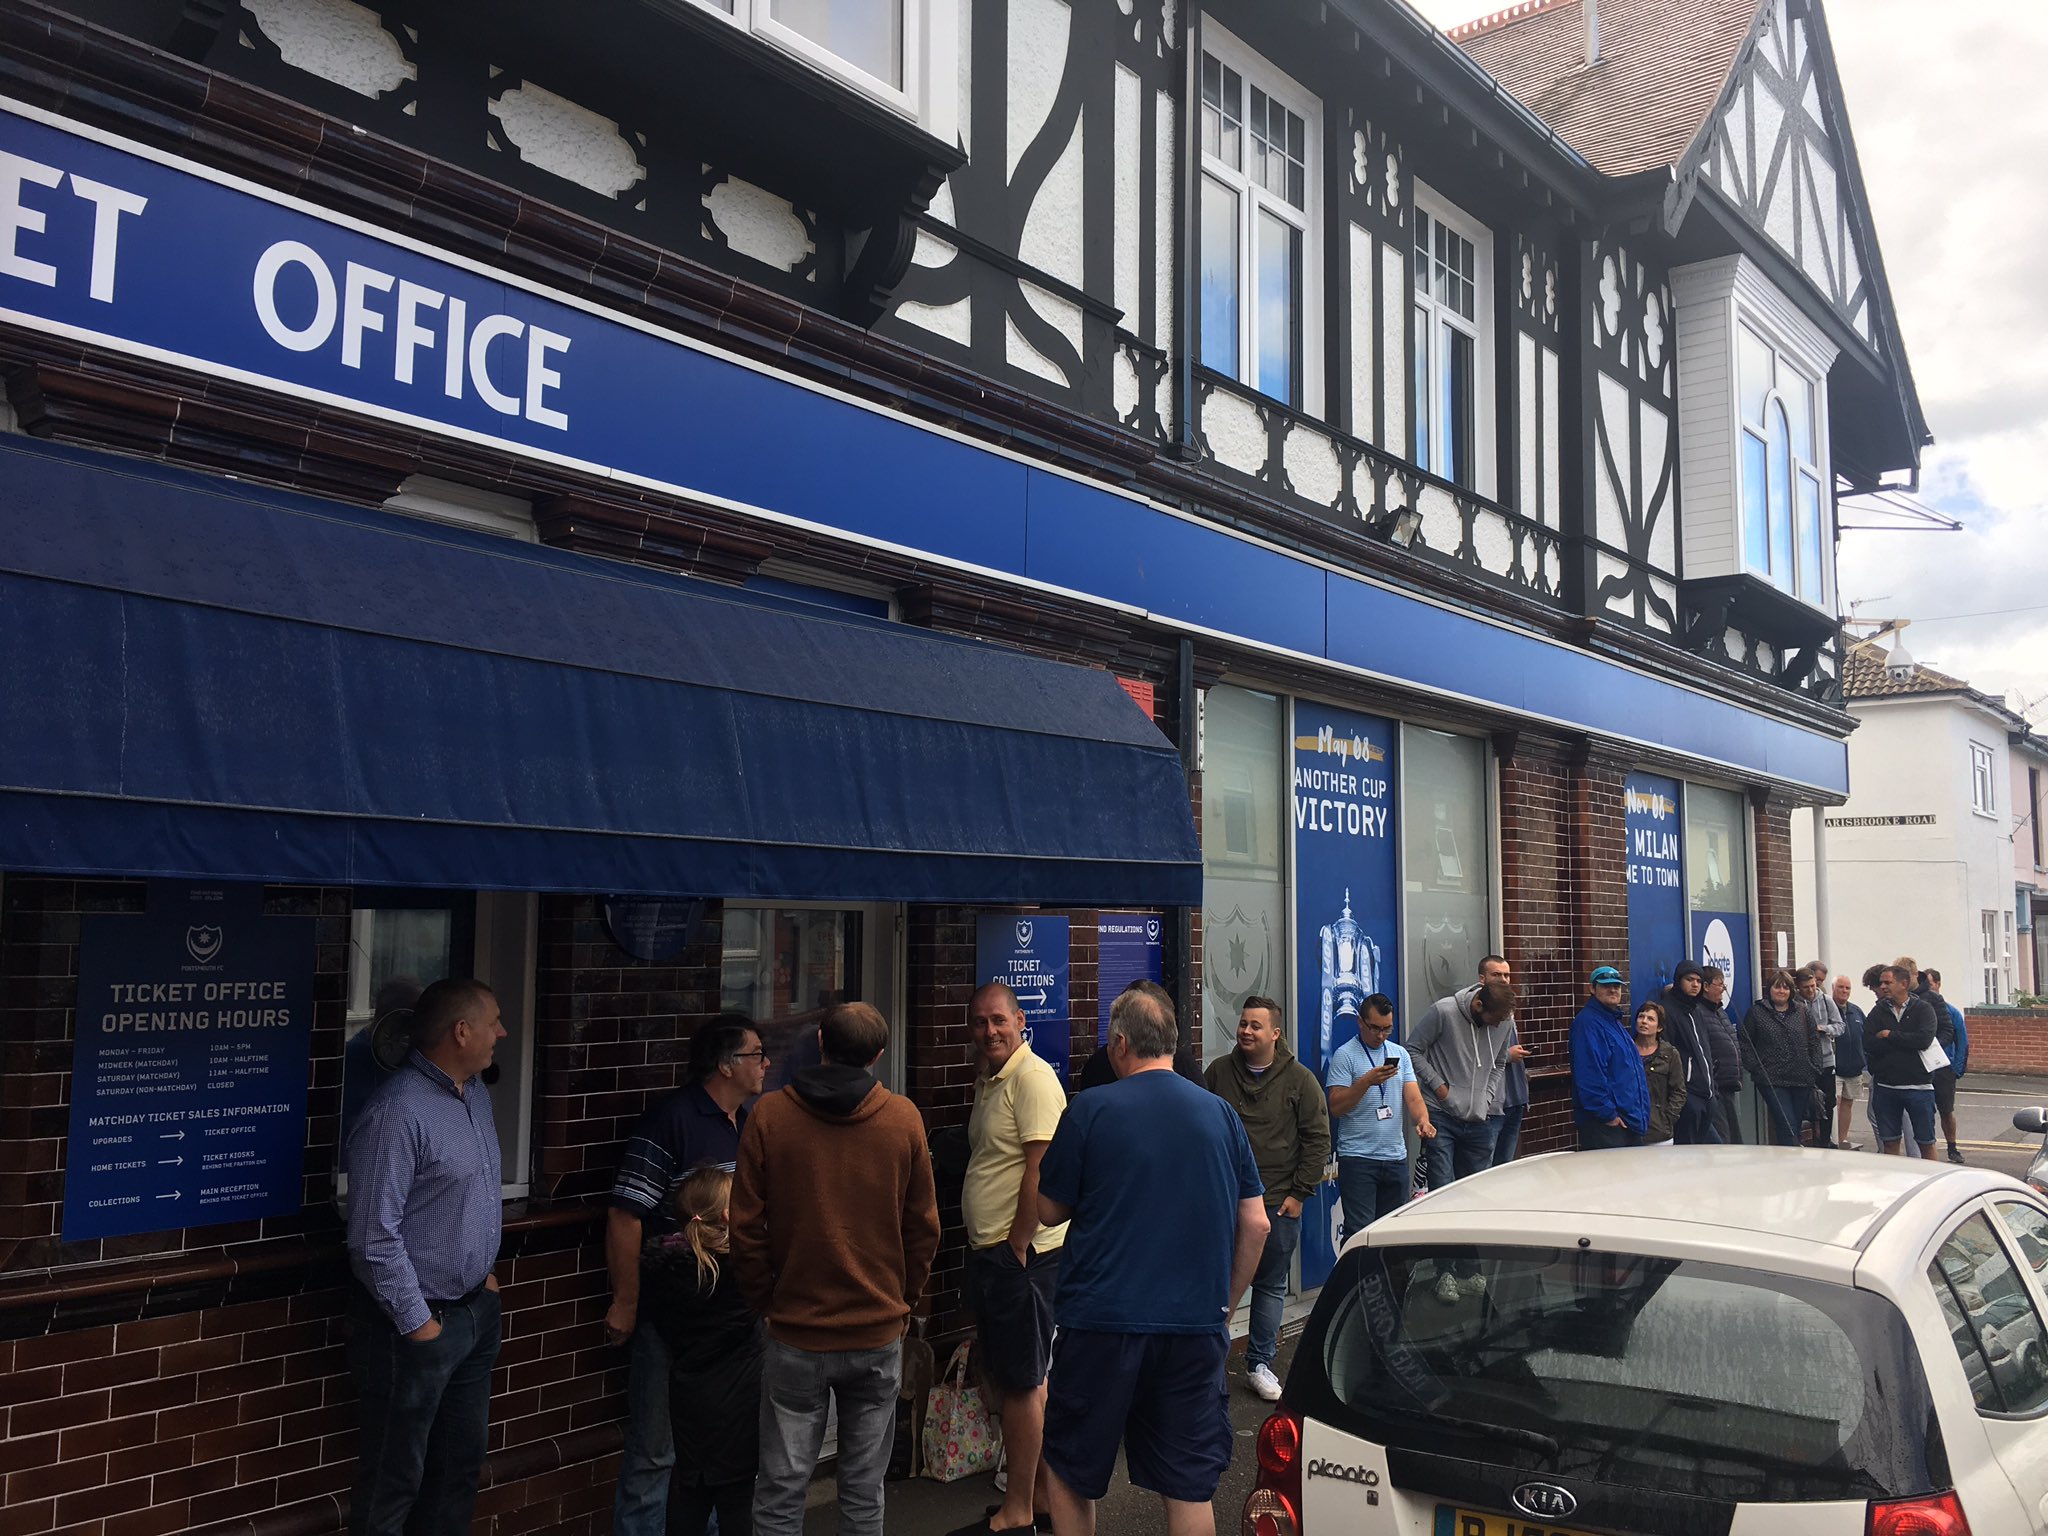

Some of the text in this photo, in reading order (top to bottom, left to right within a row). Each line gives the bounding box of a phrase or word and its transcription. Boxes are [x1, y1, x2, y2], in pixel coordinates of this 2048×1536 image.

[253, 240, 571, 431] OFFICE
[1318, 725, 1370, 768] May '08
[1295, 766, 1386, 799] ANOTHER CUP
[1627, 785, 1648, 815] Nov
[1295, 795, 1387, 838] VICTORY
[1825, 814, 1936, 827] ARISBROOKE ROAD
[1635, 828, 1678, 861] MILAN
[1641, 866, 1652, 885] TO
[1656, 867, 1679, 887] TOWN
[1108, 925, 1143, 933] REGULATIONS
[1008, 960, 1040, 972] TICKET
[992, 974, 1055, 987] COLLECTIONS
[110, 982, 286, 1003] TICKET OFFICE
[102, 1009, 290, 1032] OPENING HOURS
[99, 1048, 130, 1056] MONDAY
[98, 1058, 178, 1069] MIDWEEK (MATCHDAY)
[209, 1056, 228, 1064] 10AM
[97, 1071, 180, 1083] SATURDAY (MATCHDAY)
[208, 1069, 228, 1077] 11AM
[235, 1067, 269, 1075] HALFTIME
[96, 1083, 197, 1096] SATURDAY (NON-MATCHDAY)
[207, 1081, 235, 1089] CLOSED
[89, 1104, 290, 1126] MATCHDAY TICKET SALES INFORMATION
[204, 1126, 256, 1136] TICKET OFFICE
[92, 1136, 133, 1145] UPGRADES
[202, 1151, 255, 1161] TICKET KIOSKS
[91, 1160, 146, 1172] HOME TICKETS
[200, 1184, 259, 1195] MAIN RECEPTION
[88, 1195, 141, 1208] COLLECTIONS
[1307, 1457, 1380, 1487] picanto
[1523, 1488, 1565, 1513] KIA
